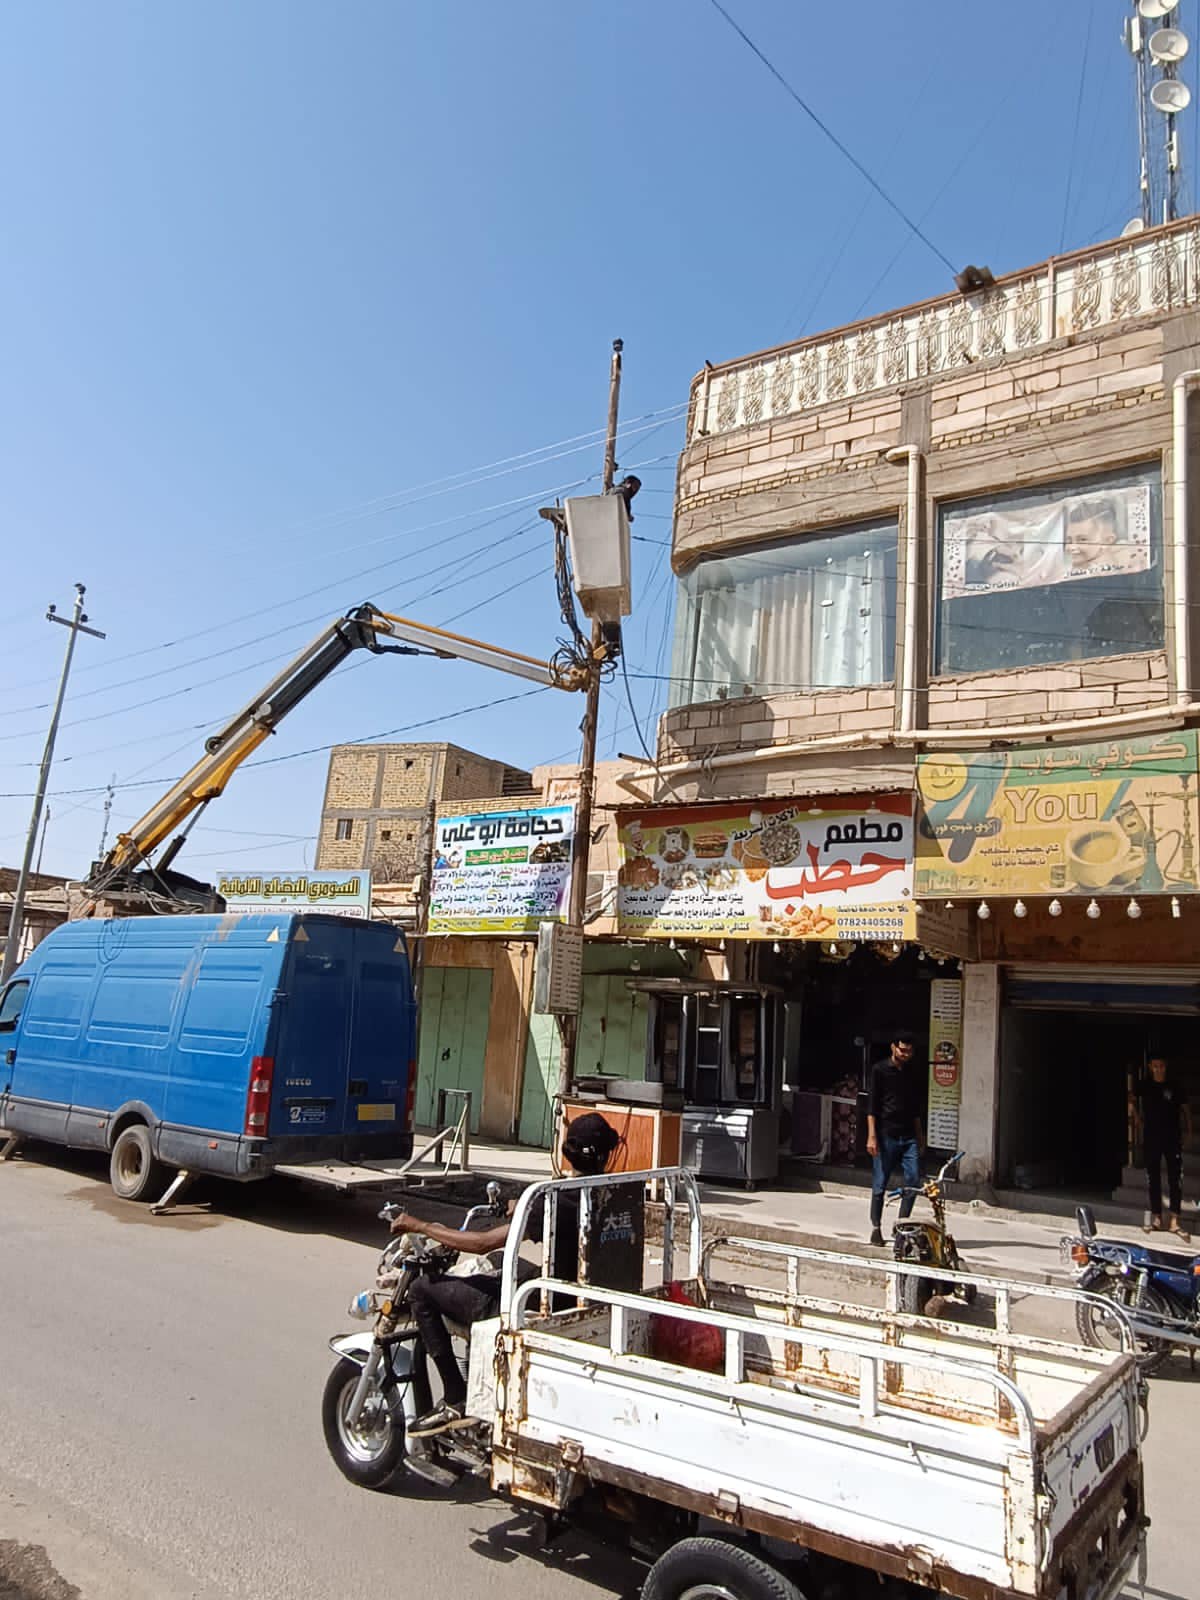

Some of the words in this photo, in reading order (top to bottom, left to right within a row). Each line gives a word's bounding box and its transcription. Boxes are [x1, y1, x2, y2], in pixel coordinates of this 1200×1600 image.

[1087, 741, 1188, 777] كوفي
[1004, 787, 1098, 823] You
[442, 823, 476, 848] علي
[504, 816, 564, 841] حجامة
[824, 818, 904, 852] مطعم
[263, 875, 307, 900] للبضائع
[309, 876, 361, 900] السومري
[765, 840, 906, 916] حطب
[286, 1078, 312, 1086] IVECO
